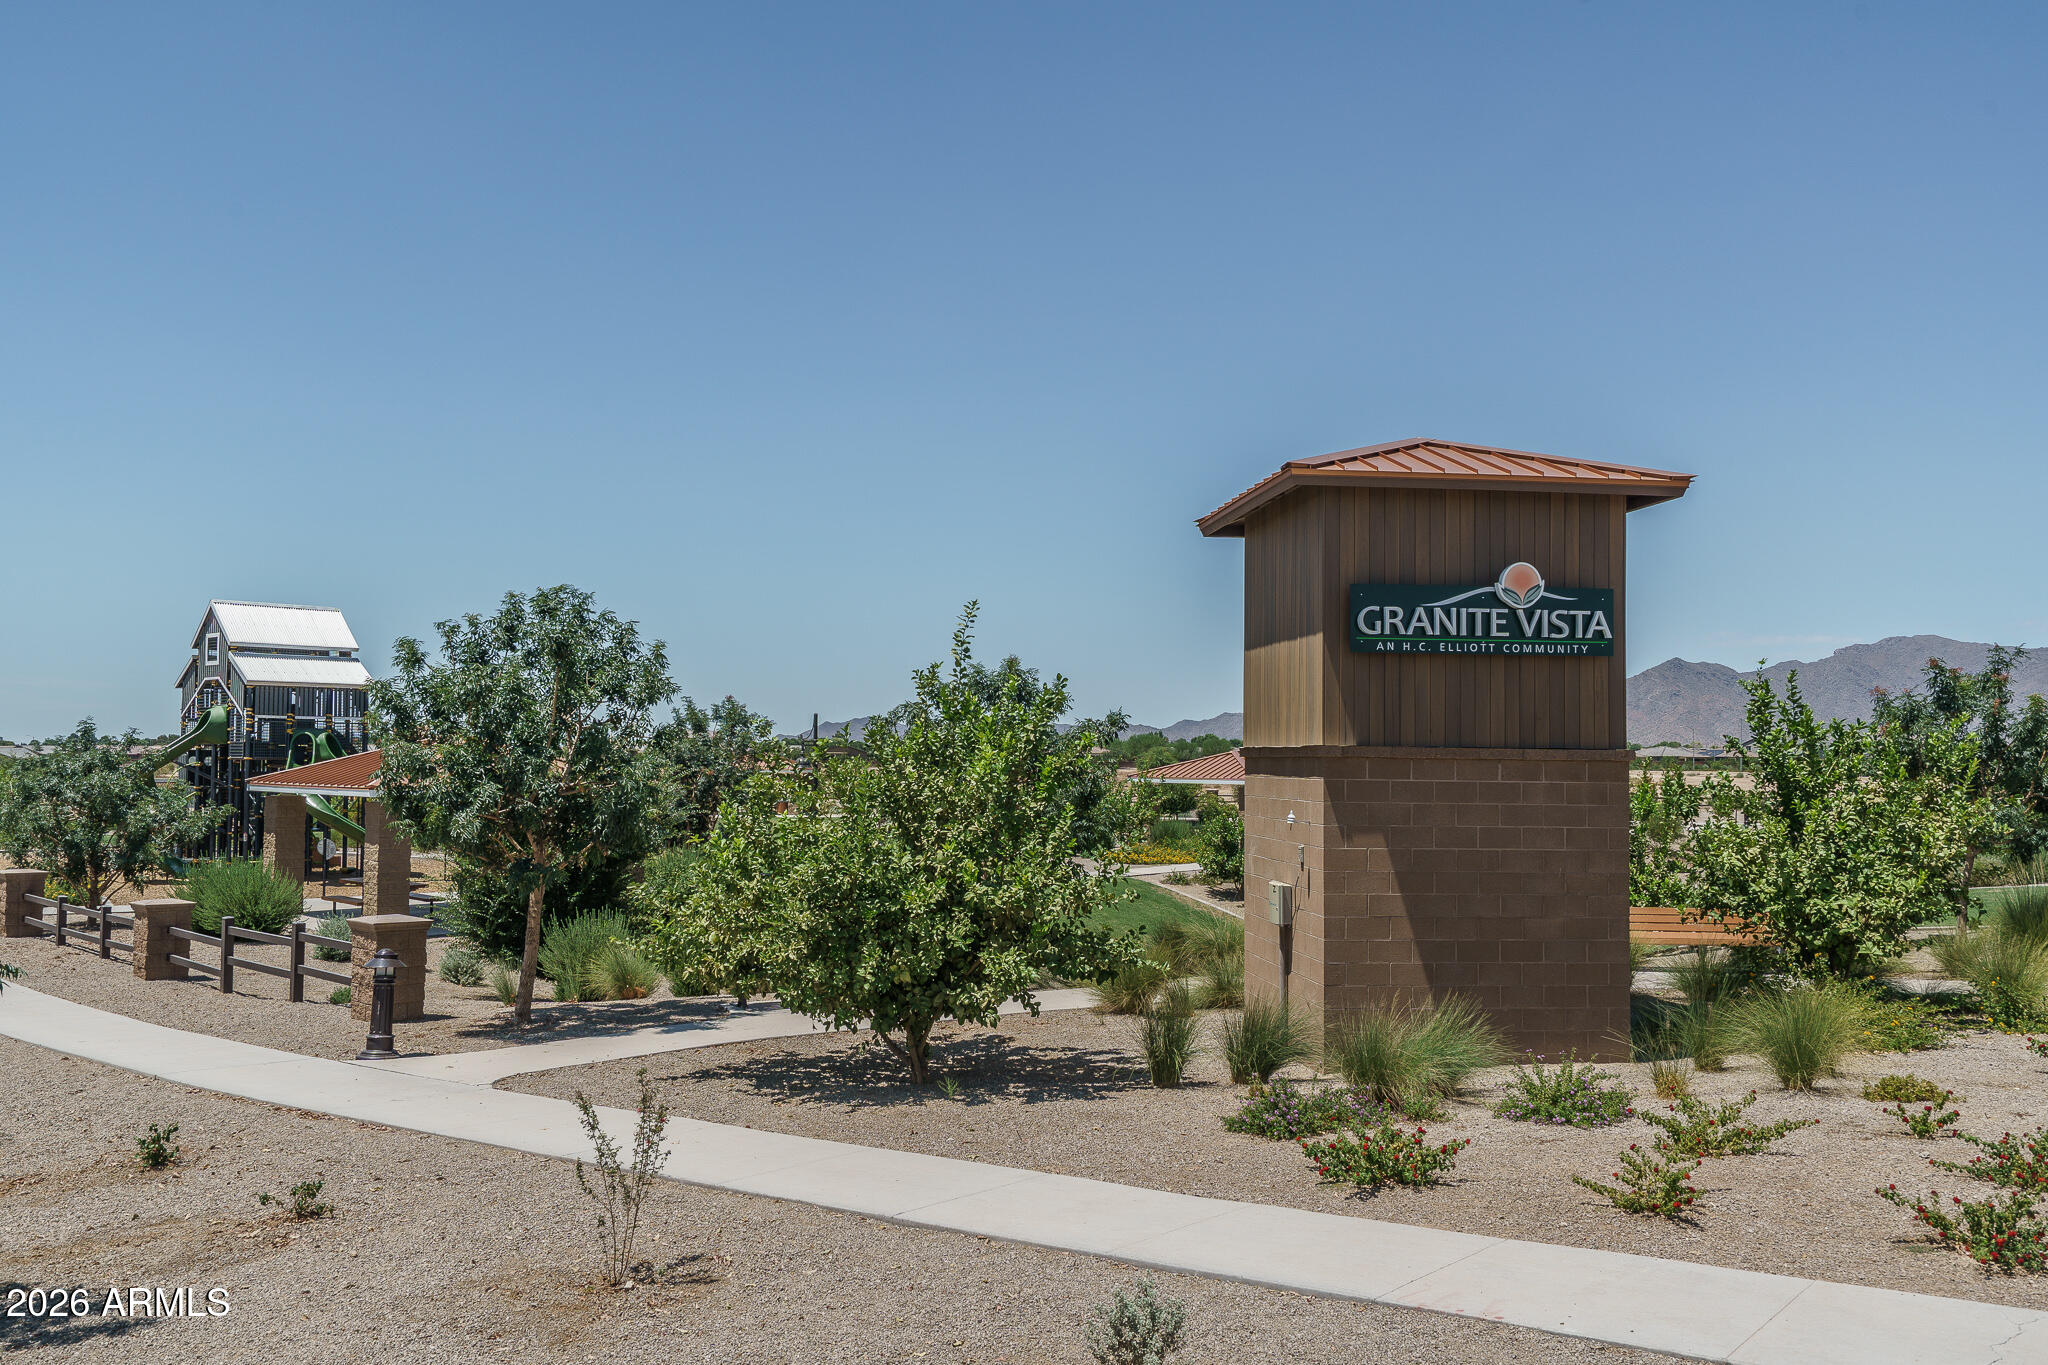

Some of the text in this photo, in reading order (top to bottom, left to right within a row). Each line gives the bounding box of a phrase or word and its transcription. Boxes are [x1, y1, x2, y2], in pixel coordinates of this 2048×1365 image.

[1357, 606, 1613, 639] GRANITE VISTA
[1376, 641, 1589, 654] AN H.C. ELLIOTT COMMUNITY
